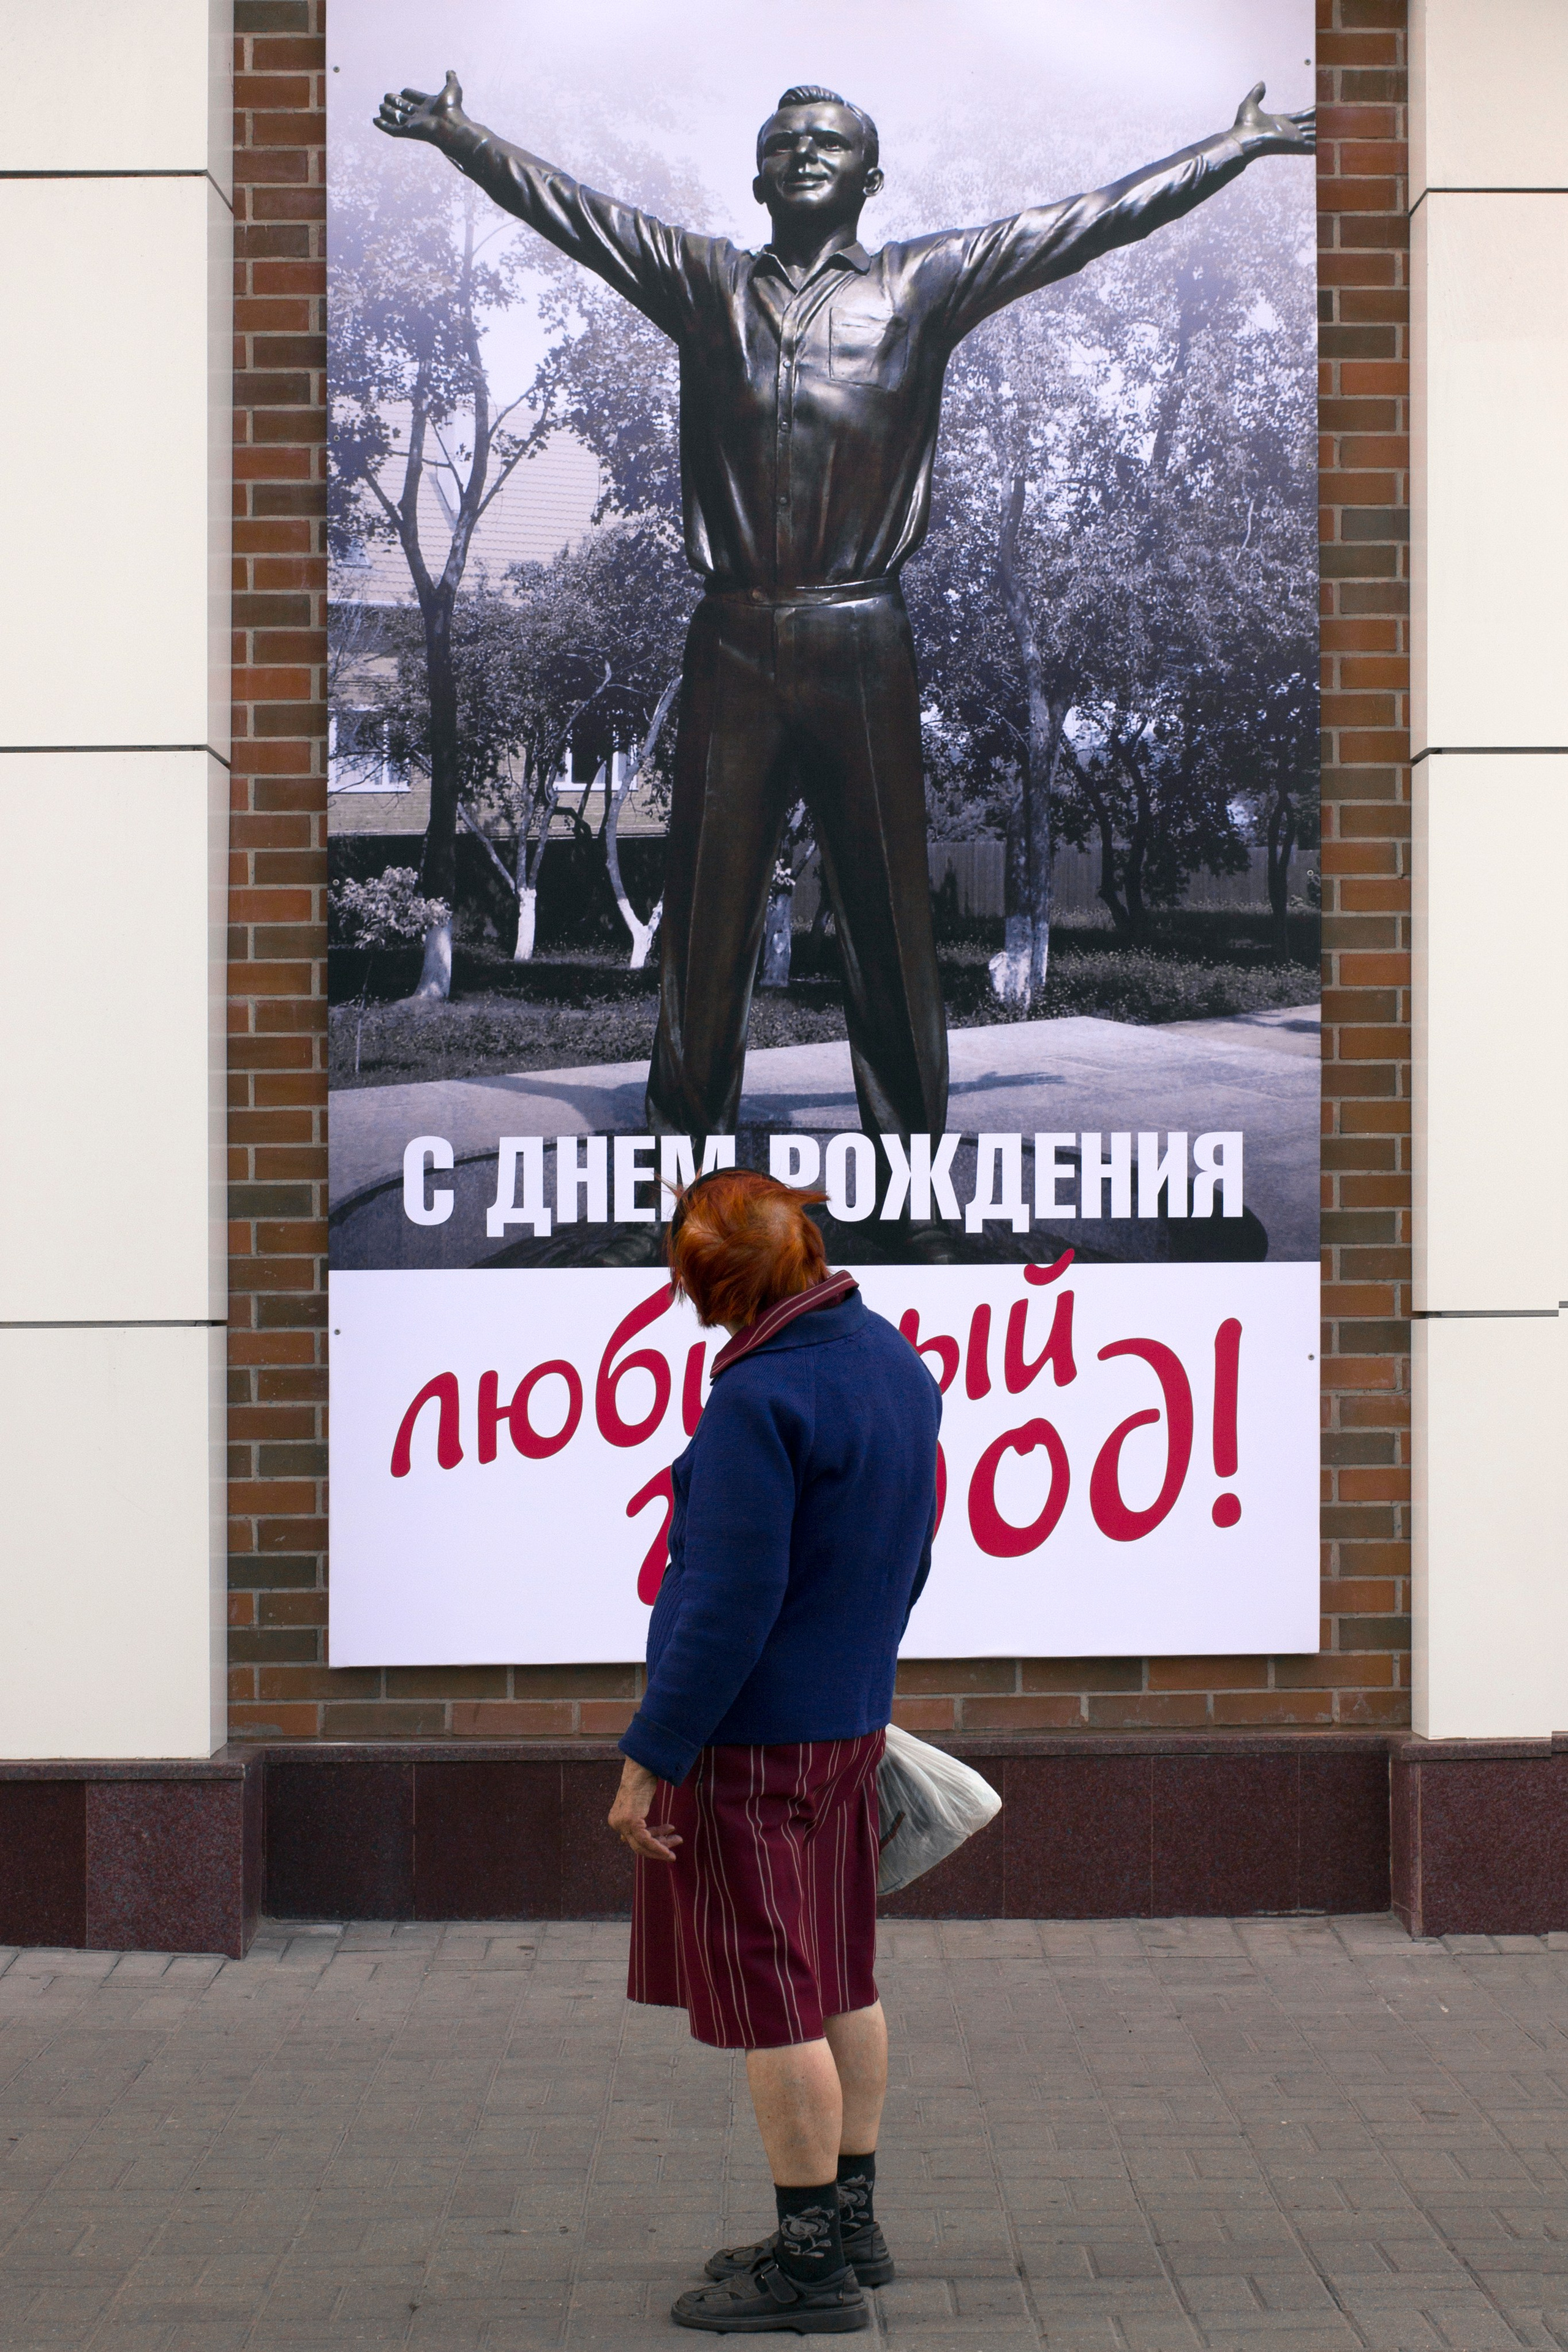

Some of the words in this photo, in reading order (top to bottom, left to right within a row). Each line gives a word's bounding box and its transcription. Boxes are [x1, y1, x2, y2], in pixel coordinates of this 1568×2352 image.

[402, 1134, 455, 1226] С
[486, 1134, 736, 1238] ДНЕМ
[769, 1131, 1244, 1234] РОЖДЕНИЯ
